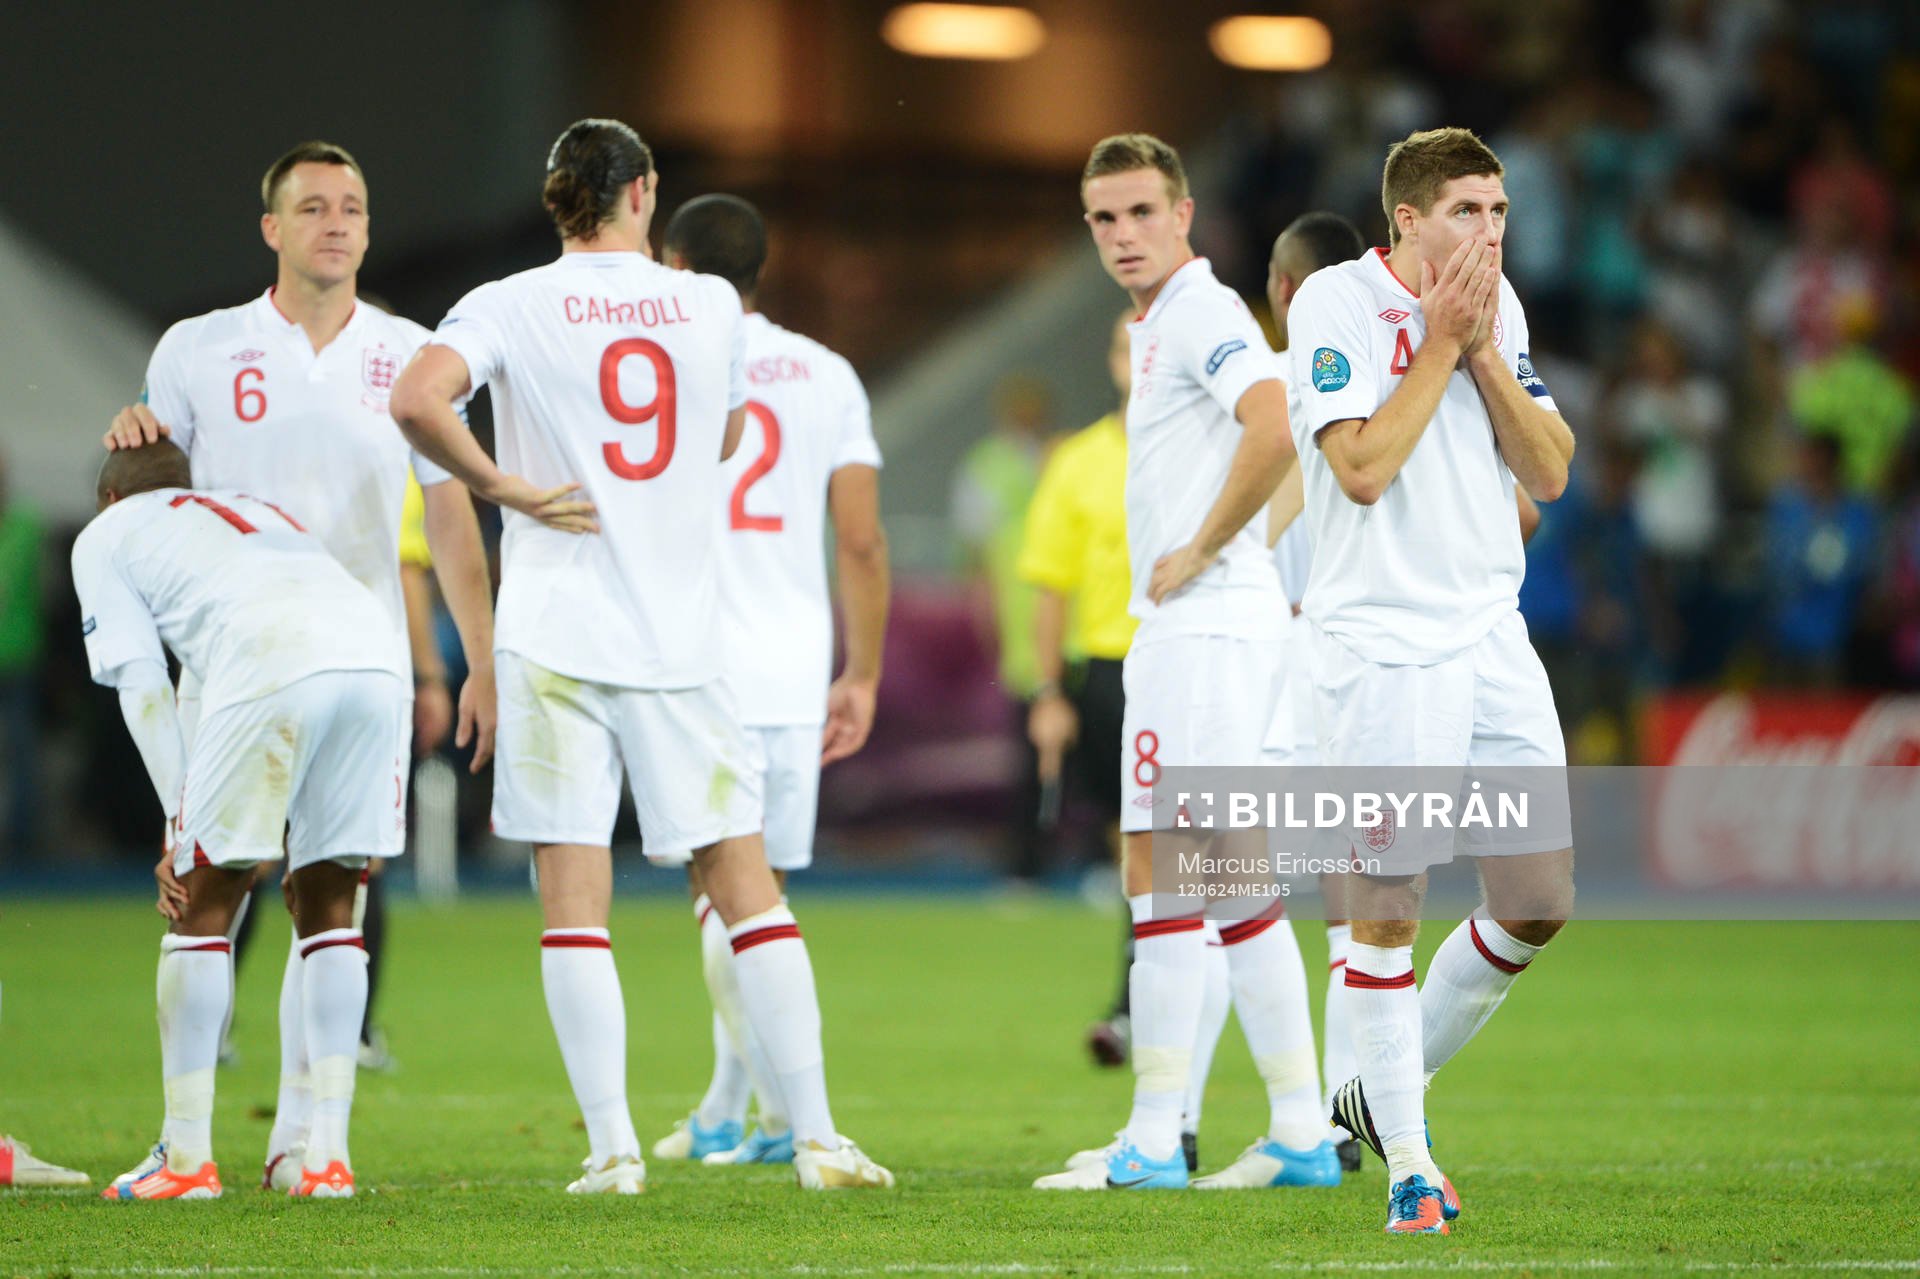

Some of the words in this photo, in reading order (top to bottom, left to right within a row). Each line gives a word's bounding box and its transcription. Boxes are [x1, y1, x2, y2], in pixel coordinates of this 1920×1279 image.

[1391, 328, 1414, 375] 4
[233, 368, 267, 422] 6
[599, 338, 676, 481] 9
[729, 400, 783, 532] 2
[1134, 729, 1161, 787] 8
